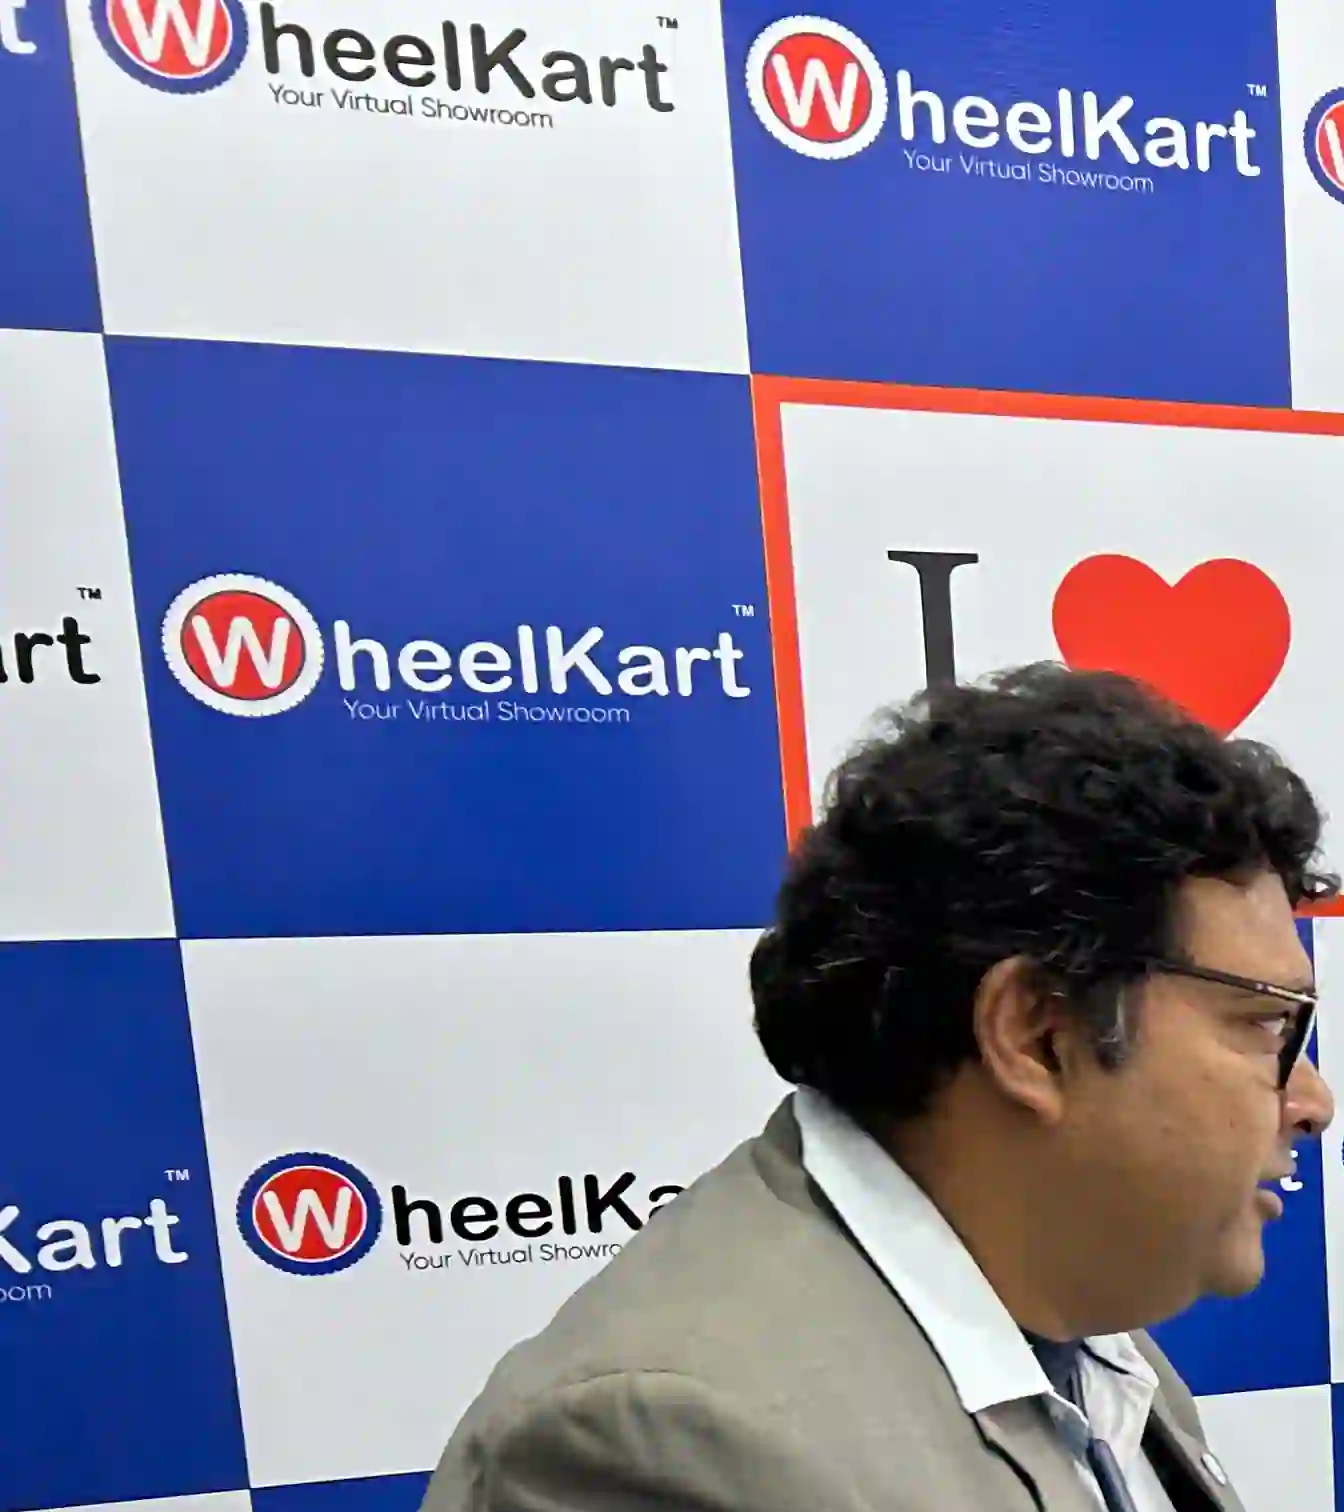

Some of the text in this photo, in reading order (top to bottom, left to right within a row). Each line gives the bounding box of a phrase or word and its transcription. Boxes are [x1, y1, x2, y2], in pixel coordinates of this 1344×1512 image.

[268, 82, 554, 130] Your Virtual Showroom
[772, 53, 1262, 178] WheelKart
[902, 147, 1155, 194] Your Virtual Showroom
[191, 613, 751, 700] WheelKart
[343, 698, 631, 724] Your Virtual Showroom
[260, 1172, 687, 1254] WheelK
[399, 1239, 624, 1272] Your Virtual Showro
